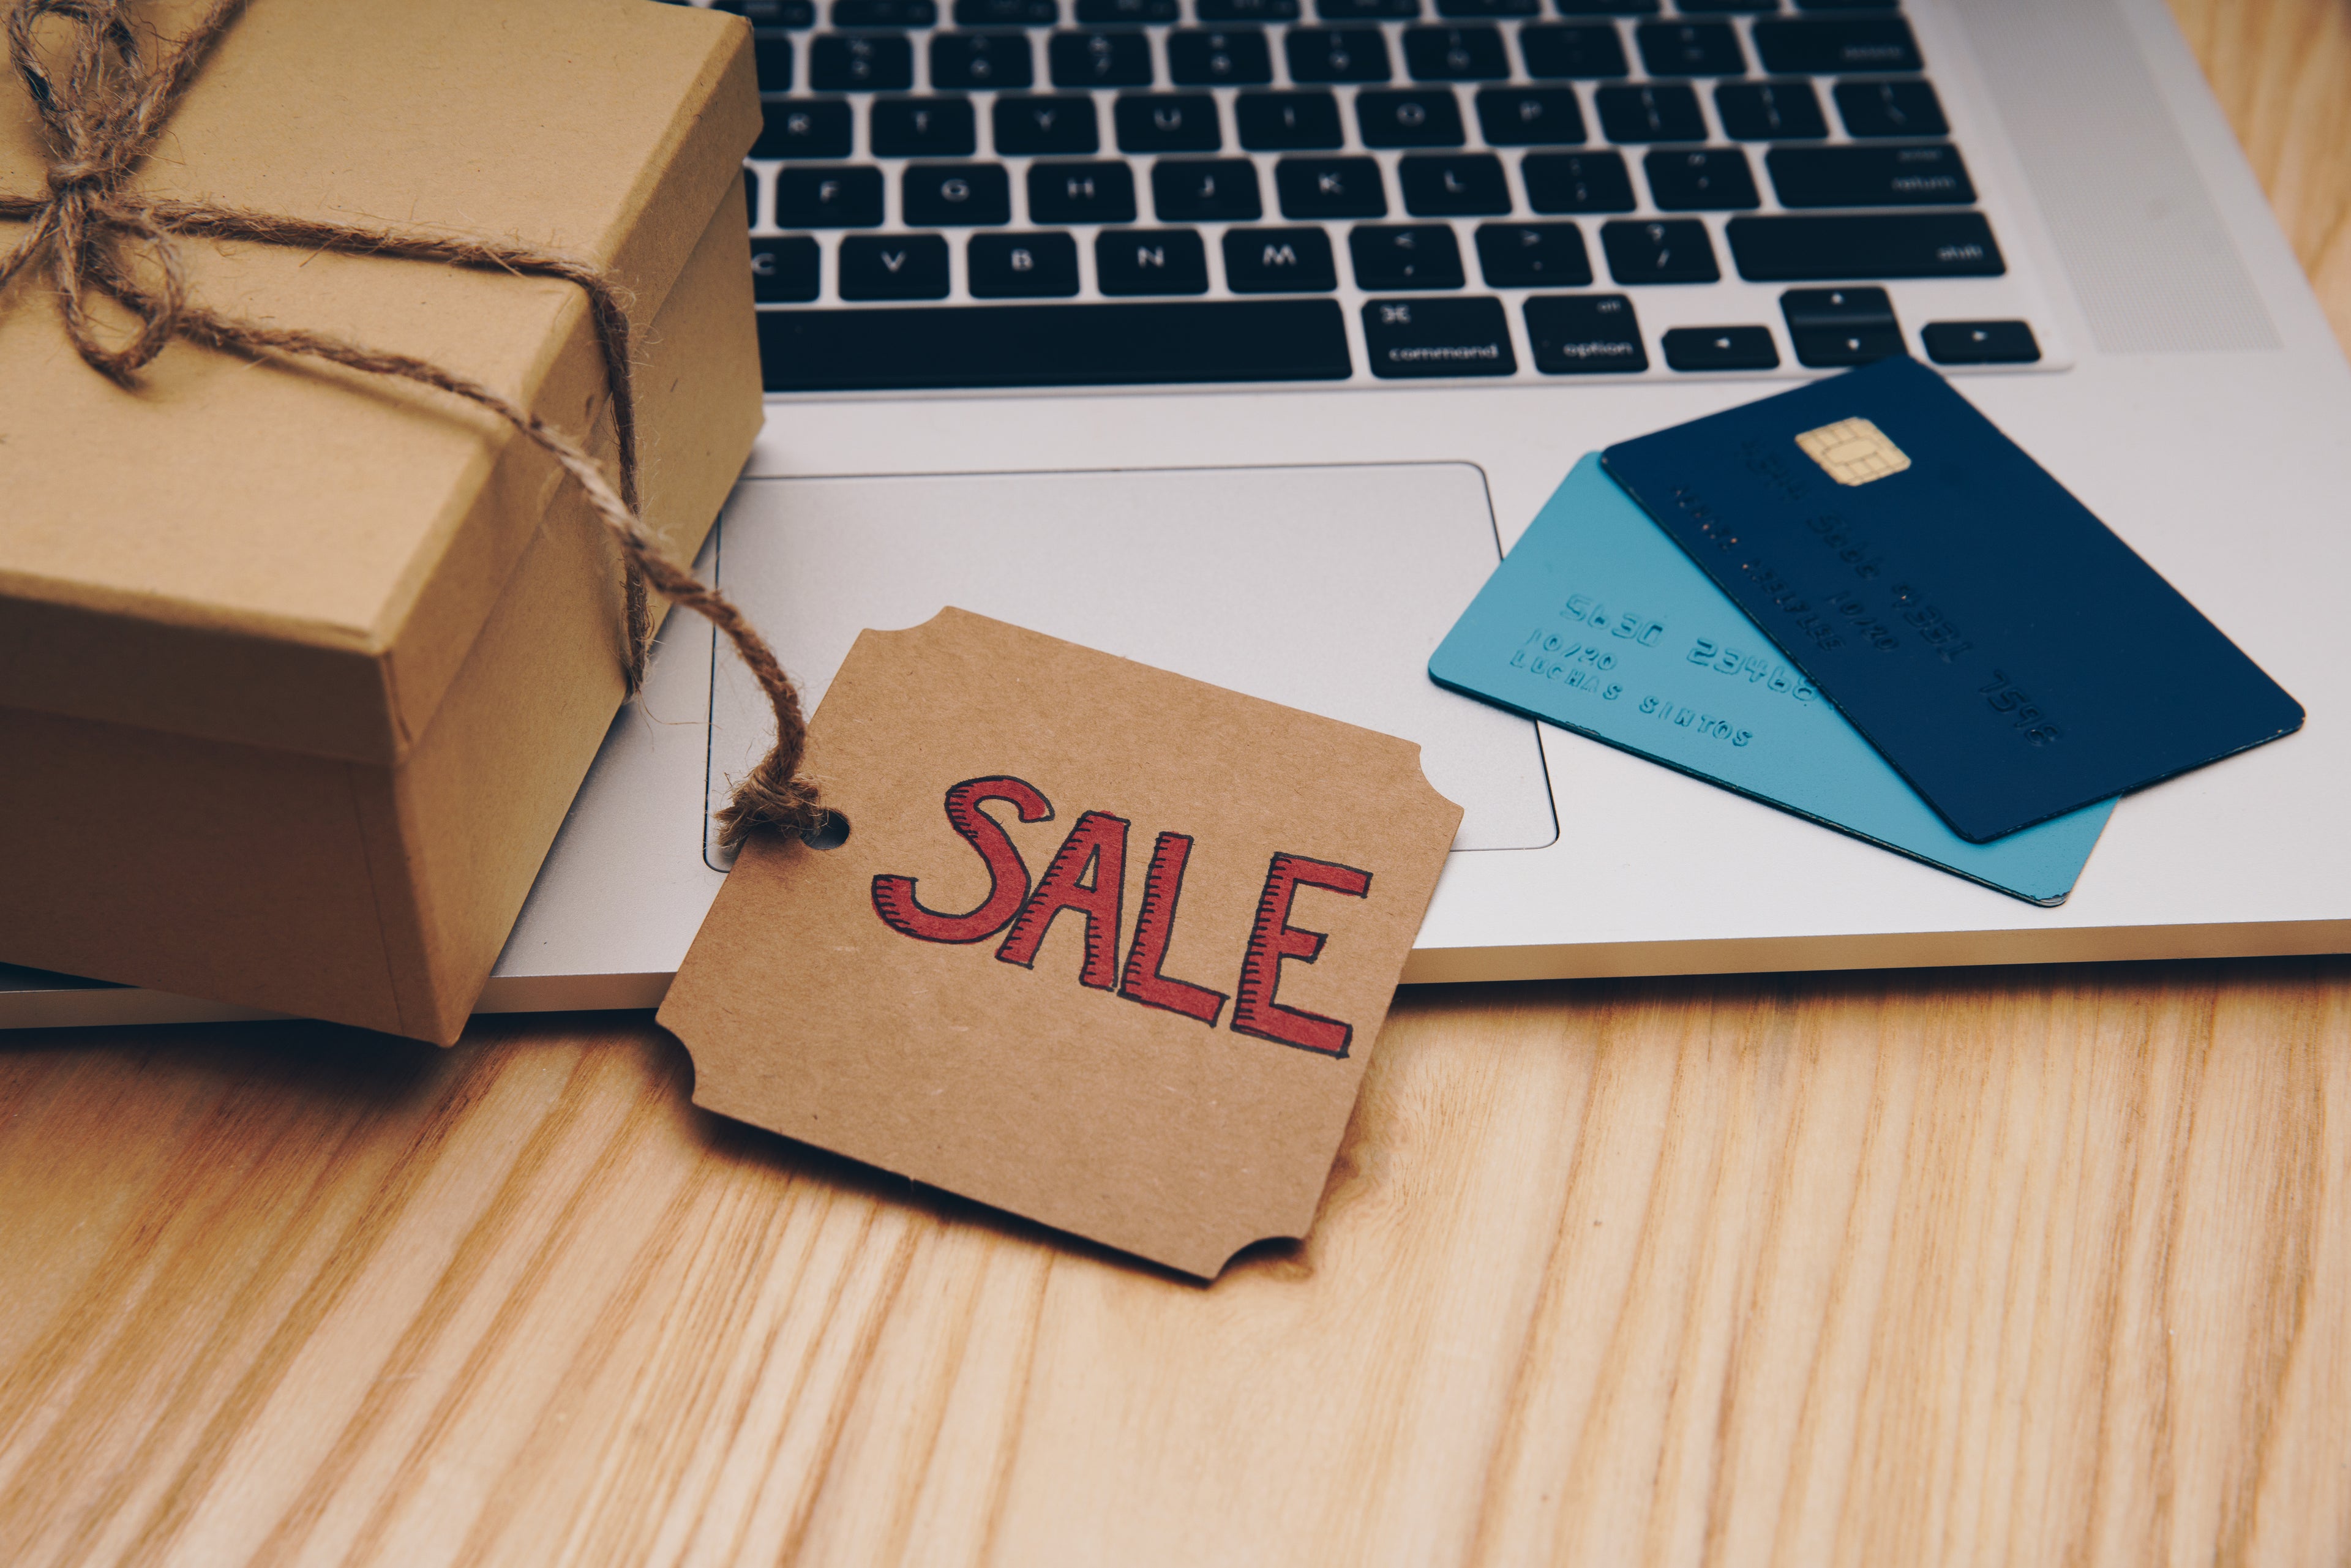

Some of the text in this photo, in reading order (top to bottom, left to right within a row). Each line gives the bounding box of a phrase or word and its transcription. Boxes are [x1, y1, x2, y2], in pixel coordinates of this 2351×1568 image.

[1035, 109, 1055, 130] Y
[1153, 107, 1182, 130] U
[1396, 102, 1425, 125] O
[819, 181, 840, 203] F
[1067, 177, 1095, 198] H
[1198, 175, 1215, 197] J
[1318, 172, 1344, 194] K
[1443, 170, 1466, 193] L
[880, 250, 907, 272] V
[1010, 248, 1033, 271] B
[1136, 246, 1165, 268] N
[1262, 244, 1297, 266] M
[1937, 244, 1984, 261] shift
[751, 252, 777, 276] C
[1596, 299, 1622, 313] alt
[1388, 343, 1499, 361] command
[1562, 339, 1633, 359] option
[1824, 590, 1900, 651] 10/20
[1523, 628, 1618, 672] 10/20
[1638, 695, 1753, 748] SINTOS
[871, 775, 1374, 1058] SALE
